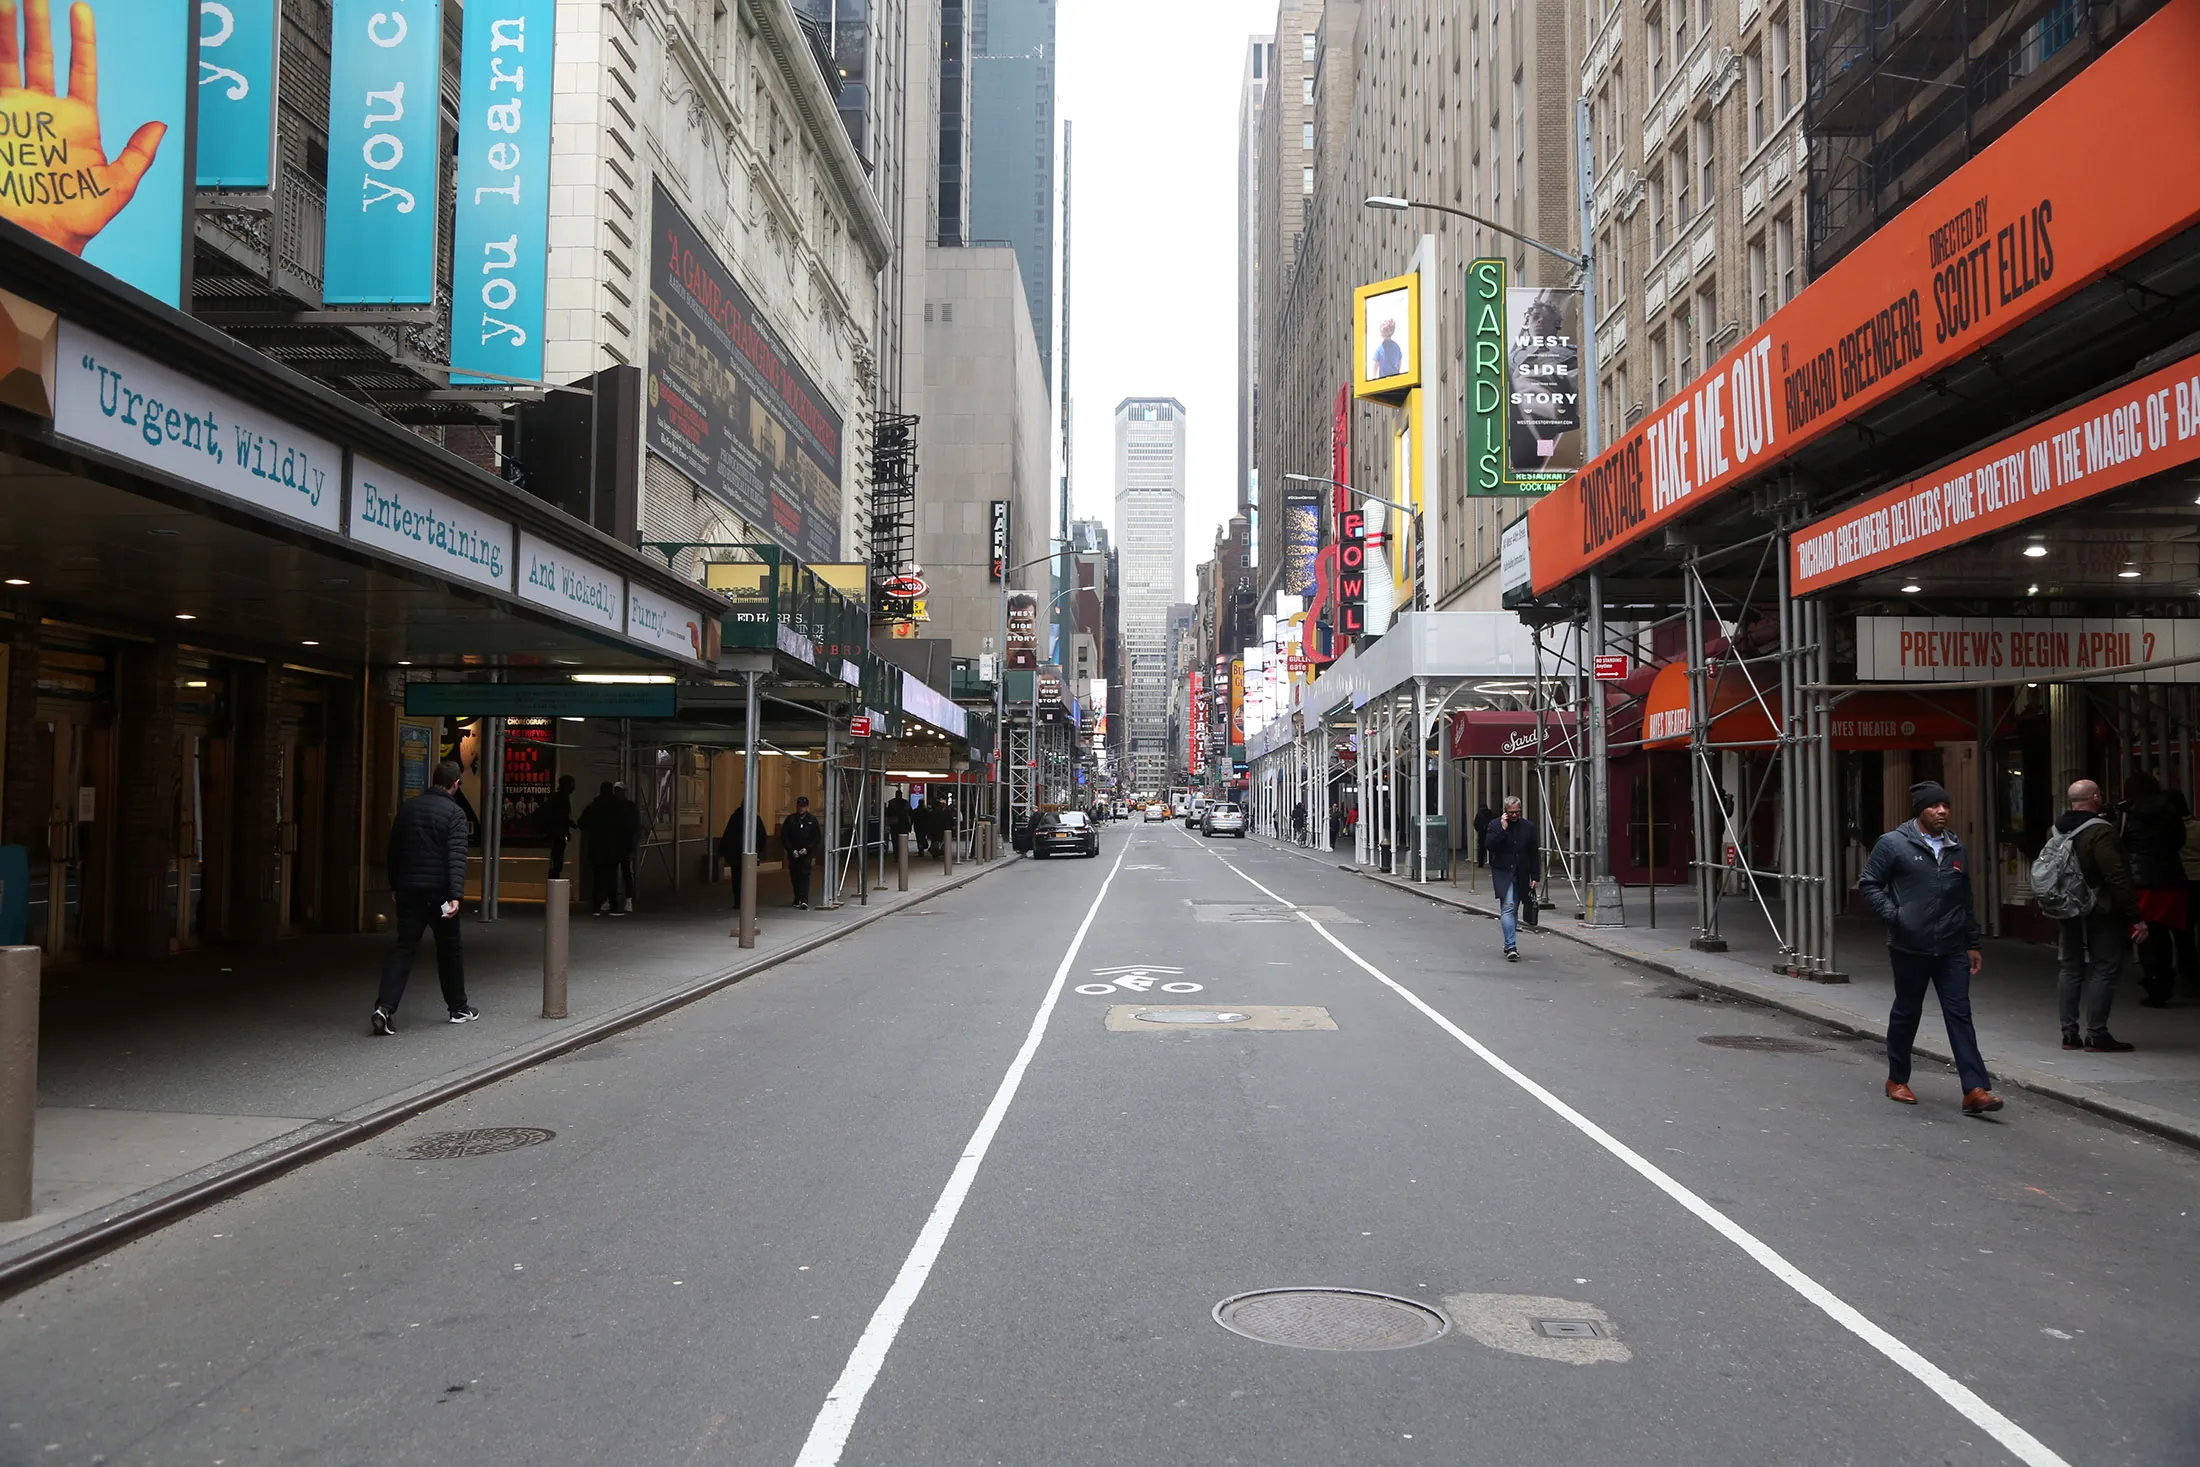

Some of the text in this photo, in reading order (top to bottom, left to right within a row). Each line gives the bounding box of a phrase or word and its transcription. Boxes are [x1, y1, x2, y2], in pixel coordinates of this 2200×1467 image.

[363, 11, 416, 214] you c
[0, 138, 68, 167] NEW
[0, 168, 111, 206] MUSICAL
[475, 16, 527, 347] you learn
[1929, 194, 1988, 269] DIRECTED BY
[1933, 198, 2054, 344] SCOTT ELLIS
[1515, 335, 1570, 347] WEST
[1519, 363, 1568, 376] SIDE
[1781, 340, 1790, 372] BY
[1783, 288, 1923, 435] RICHARD GREENBERG
[1510, 392, 1578, 405] STORY
[1647, 400, 1692, 514] TAKE
[1694, 372, 1729, 487] ME
[1731, 333, 1774, 464] OUT
[235, 424, 325, 507] Wildly
[1836, 507, 1890, 567] GREENBERG
[1890, 486, 1942, 547] DELIVERS
[1943, 472, 1975, 528] PURE
[1976, 449, 2025, 516] POETRY
[2029, 440, 2051, 496] ON
[2052, 425, 2084, 486] THE
[2084, 400, 2143, 475] MAGIC
[2146, 388, 2170, 452] OF
[361, 482, 503, 578] Entertaining,
[528, 553, 617, 621] And Wickedly
[1343, 513, 1363, 630] BOWL
[736, 612, 755, 623] ED
[1900, 631, 2004, 668] PREVIEWS
[2011, 631, 2071, 668] BEGIN
[2077, 631, 2132, 668] APRIL
[1831, 720, 1854, 737] AYES
[1857, 720, 1897, 737] THEATER
